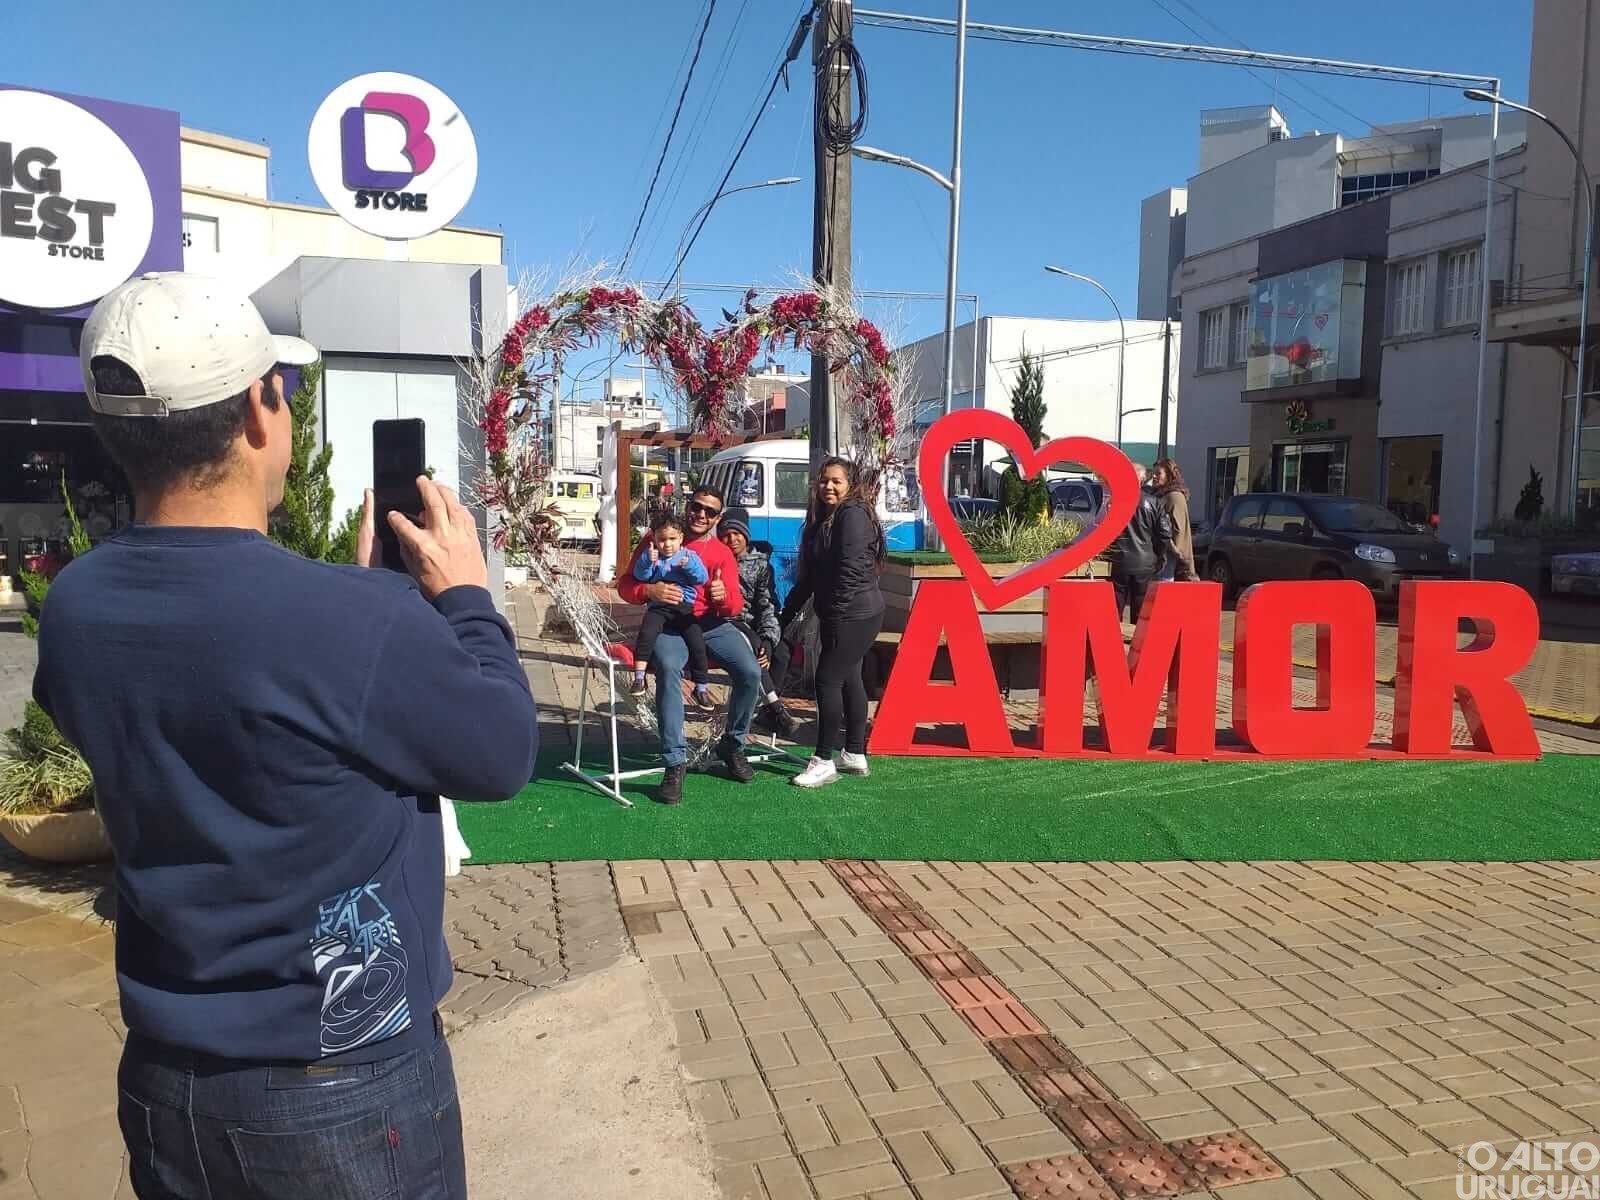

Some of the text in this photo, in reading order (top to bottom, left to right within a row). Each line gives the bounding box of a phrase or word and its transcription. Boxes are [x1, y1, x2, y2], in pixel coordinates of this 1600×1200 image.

[355, 190, 428, 213] STORE
[48, 243, 104, 261] STORE
[867, 580, 1540, 755] AMOR
